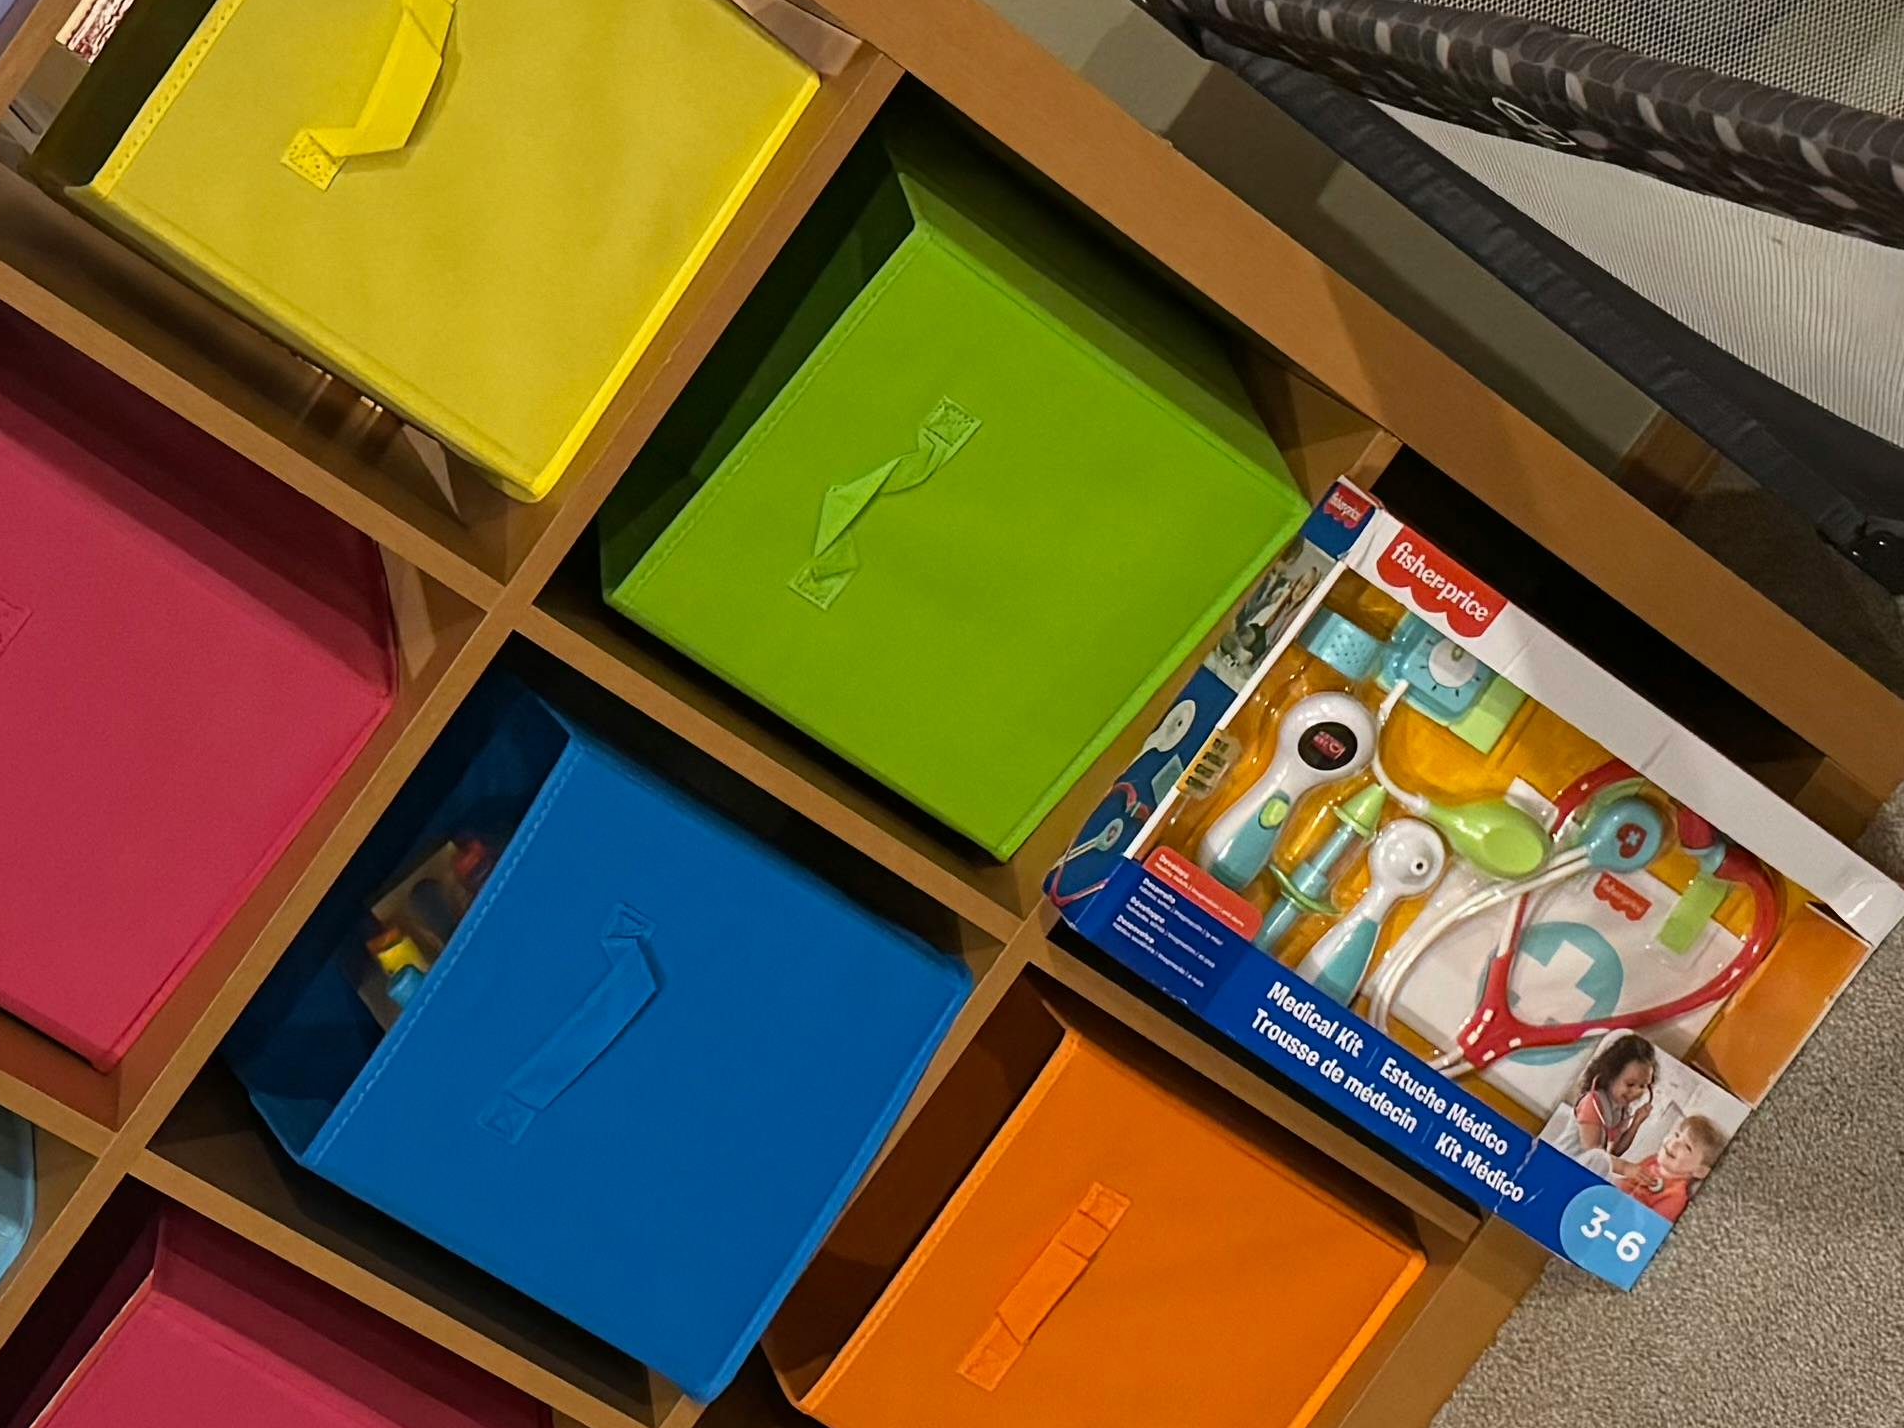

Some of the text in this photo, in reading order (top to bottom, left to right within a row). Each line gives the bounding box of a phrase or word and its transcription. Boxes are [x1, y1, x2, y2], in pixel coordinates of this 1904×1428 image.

[1390, 541, 1489, 622] fisher-price
[1266, 981, 1364, 1059] Medical Kit
[1251, 1008, 1418, 1134] Trousse de médecin
[1379, 1057, 1508, 1156] Estuche Médico
[1434, 1131, 1525, 1203] Kit Médico
[1580, 1205, 1646, 1262] 3-6
